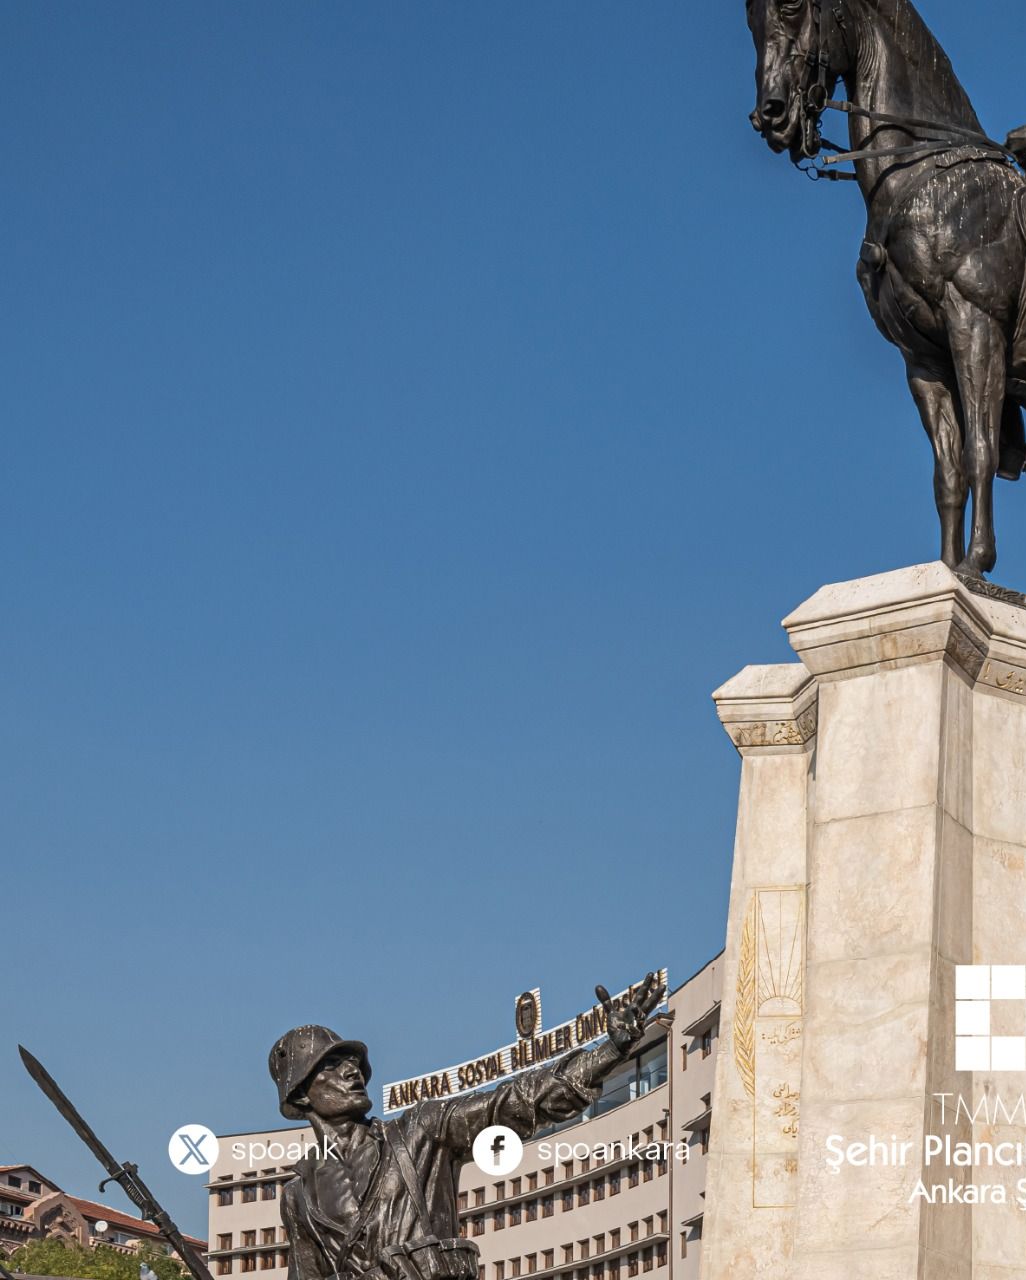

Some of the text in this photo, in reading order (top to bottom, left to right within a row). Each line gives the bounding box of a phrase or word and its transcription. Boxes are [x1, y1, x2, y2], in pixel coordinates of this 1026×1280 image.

[388, 1071, 450, 1110] ANKARA
[458, 1052, 505, 1091] SOSYAL
[511, 1025, 571, 1071] BİLİMLER
